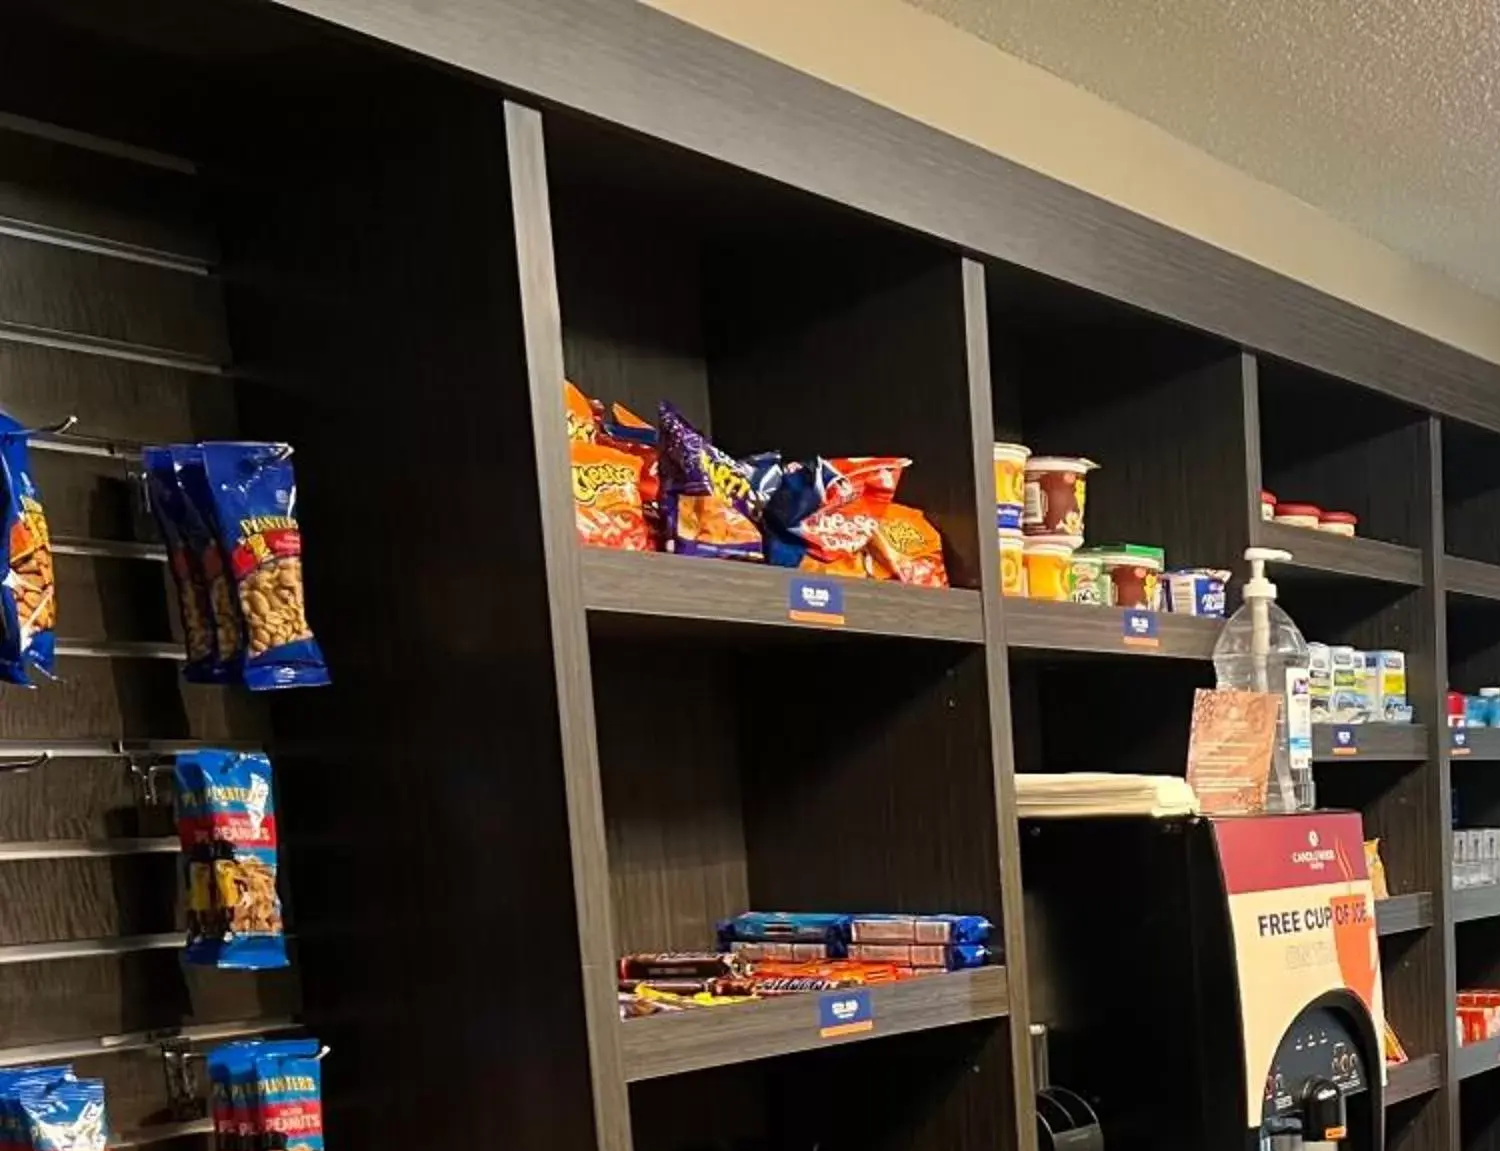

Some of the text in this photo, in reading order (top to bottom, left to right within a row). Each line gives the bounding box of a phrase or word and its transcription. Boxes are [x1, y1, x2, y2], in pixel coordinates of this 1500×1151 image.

[1258, 911, 1300, 937] FREE
[1304, 905, 1332, 930] CUP
[1335, 904, 1350, 926] OF
[258, 1074, 316, 1094] PLANTERS
[265, 1112, 320, 1131] PEANUTS
